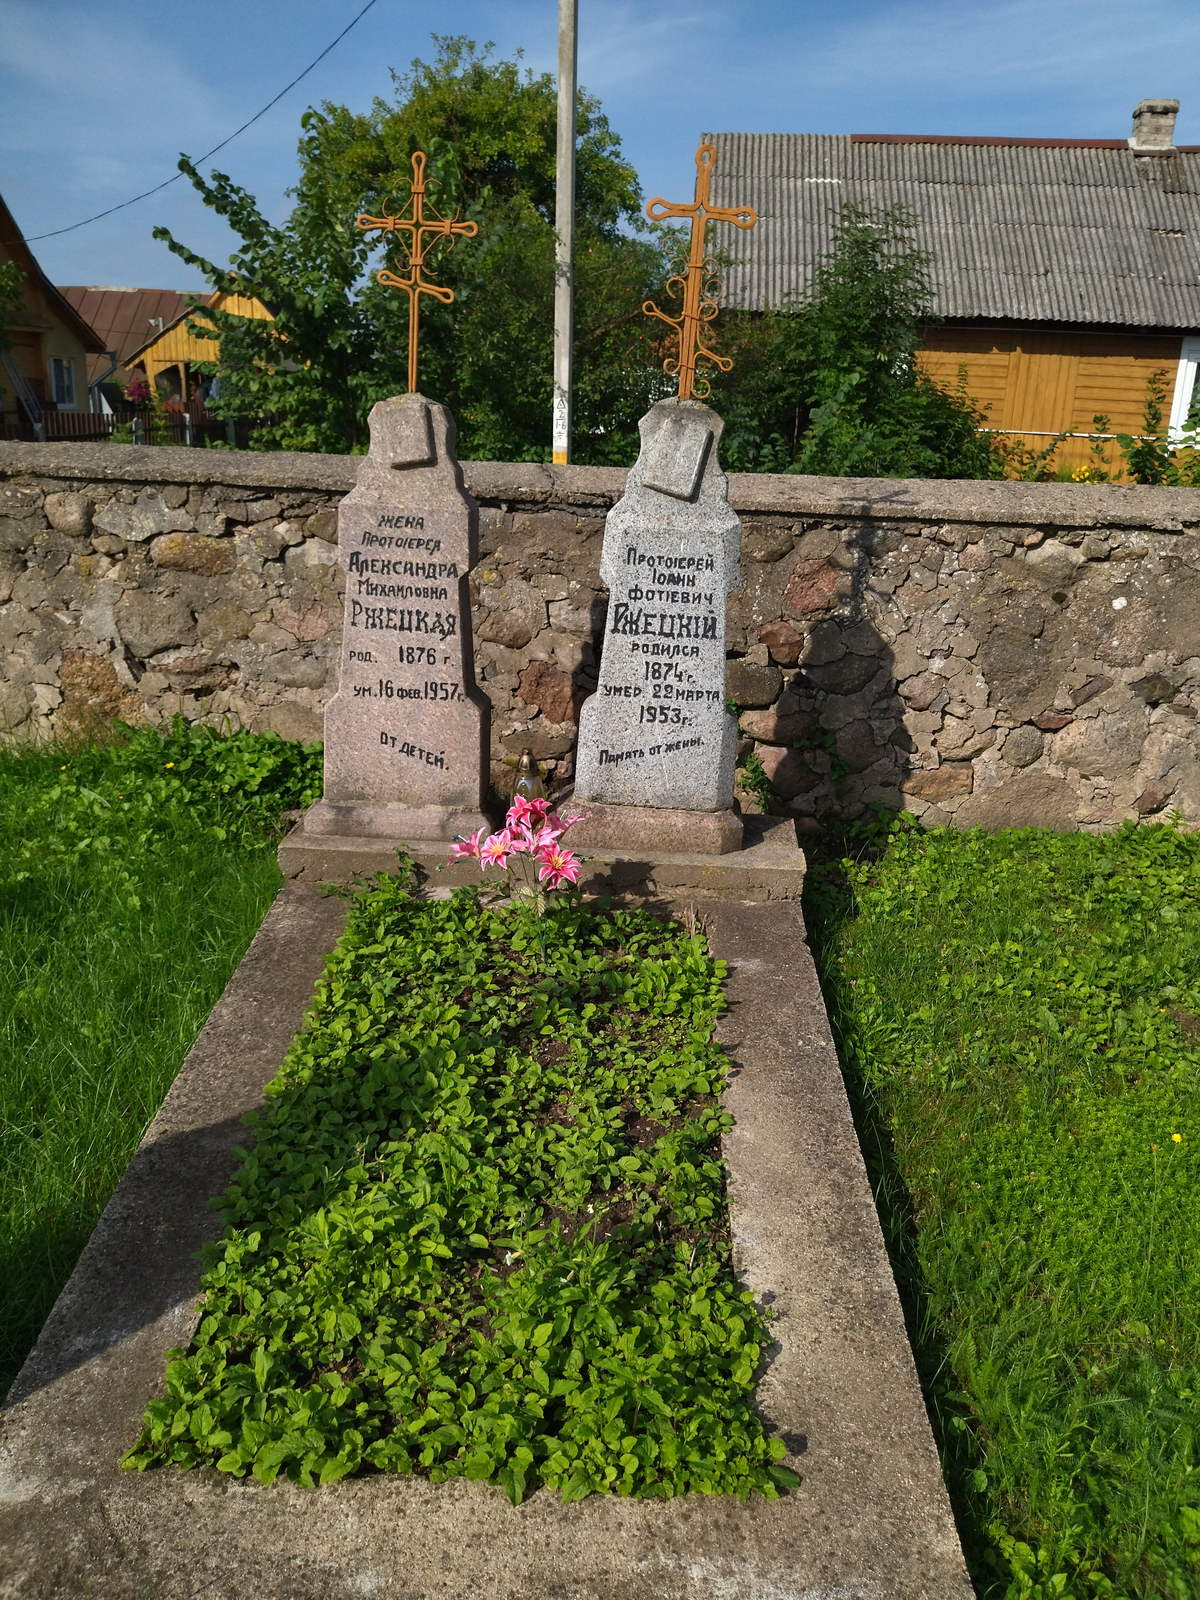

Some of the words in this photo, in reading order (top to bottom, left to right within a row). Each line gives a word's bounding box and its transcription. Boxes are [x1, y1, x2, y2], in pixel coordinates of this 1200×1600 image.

[378, 515, 425, 529] ЖЕНА
[348, 551, 459, 580] АЛЕКСАНДРА
[351, 599, 457, 641] РЖЕЦКАЯ
[399, 645, 437, 665] 1876
[632, 642, 700, 658] РОДИЛСЯ
[379, 679, 394, 698] 16
[604, 685, 642, 698] УМЕР
[652, 684, 673, 699] 22
[675, 689, 720, 701] МАРТА
[380, 731, 397, 748] ОТ
[399, 742, 449, 771] ДЕТЕЙ.
